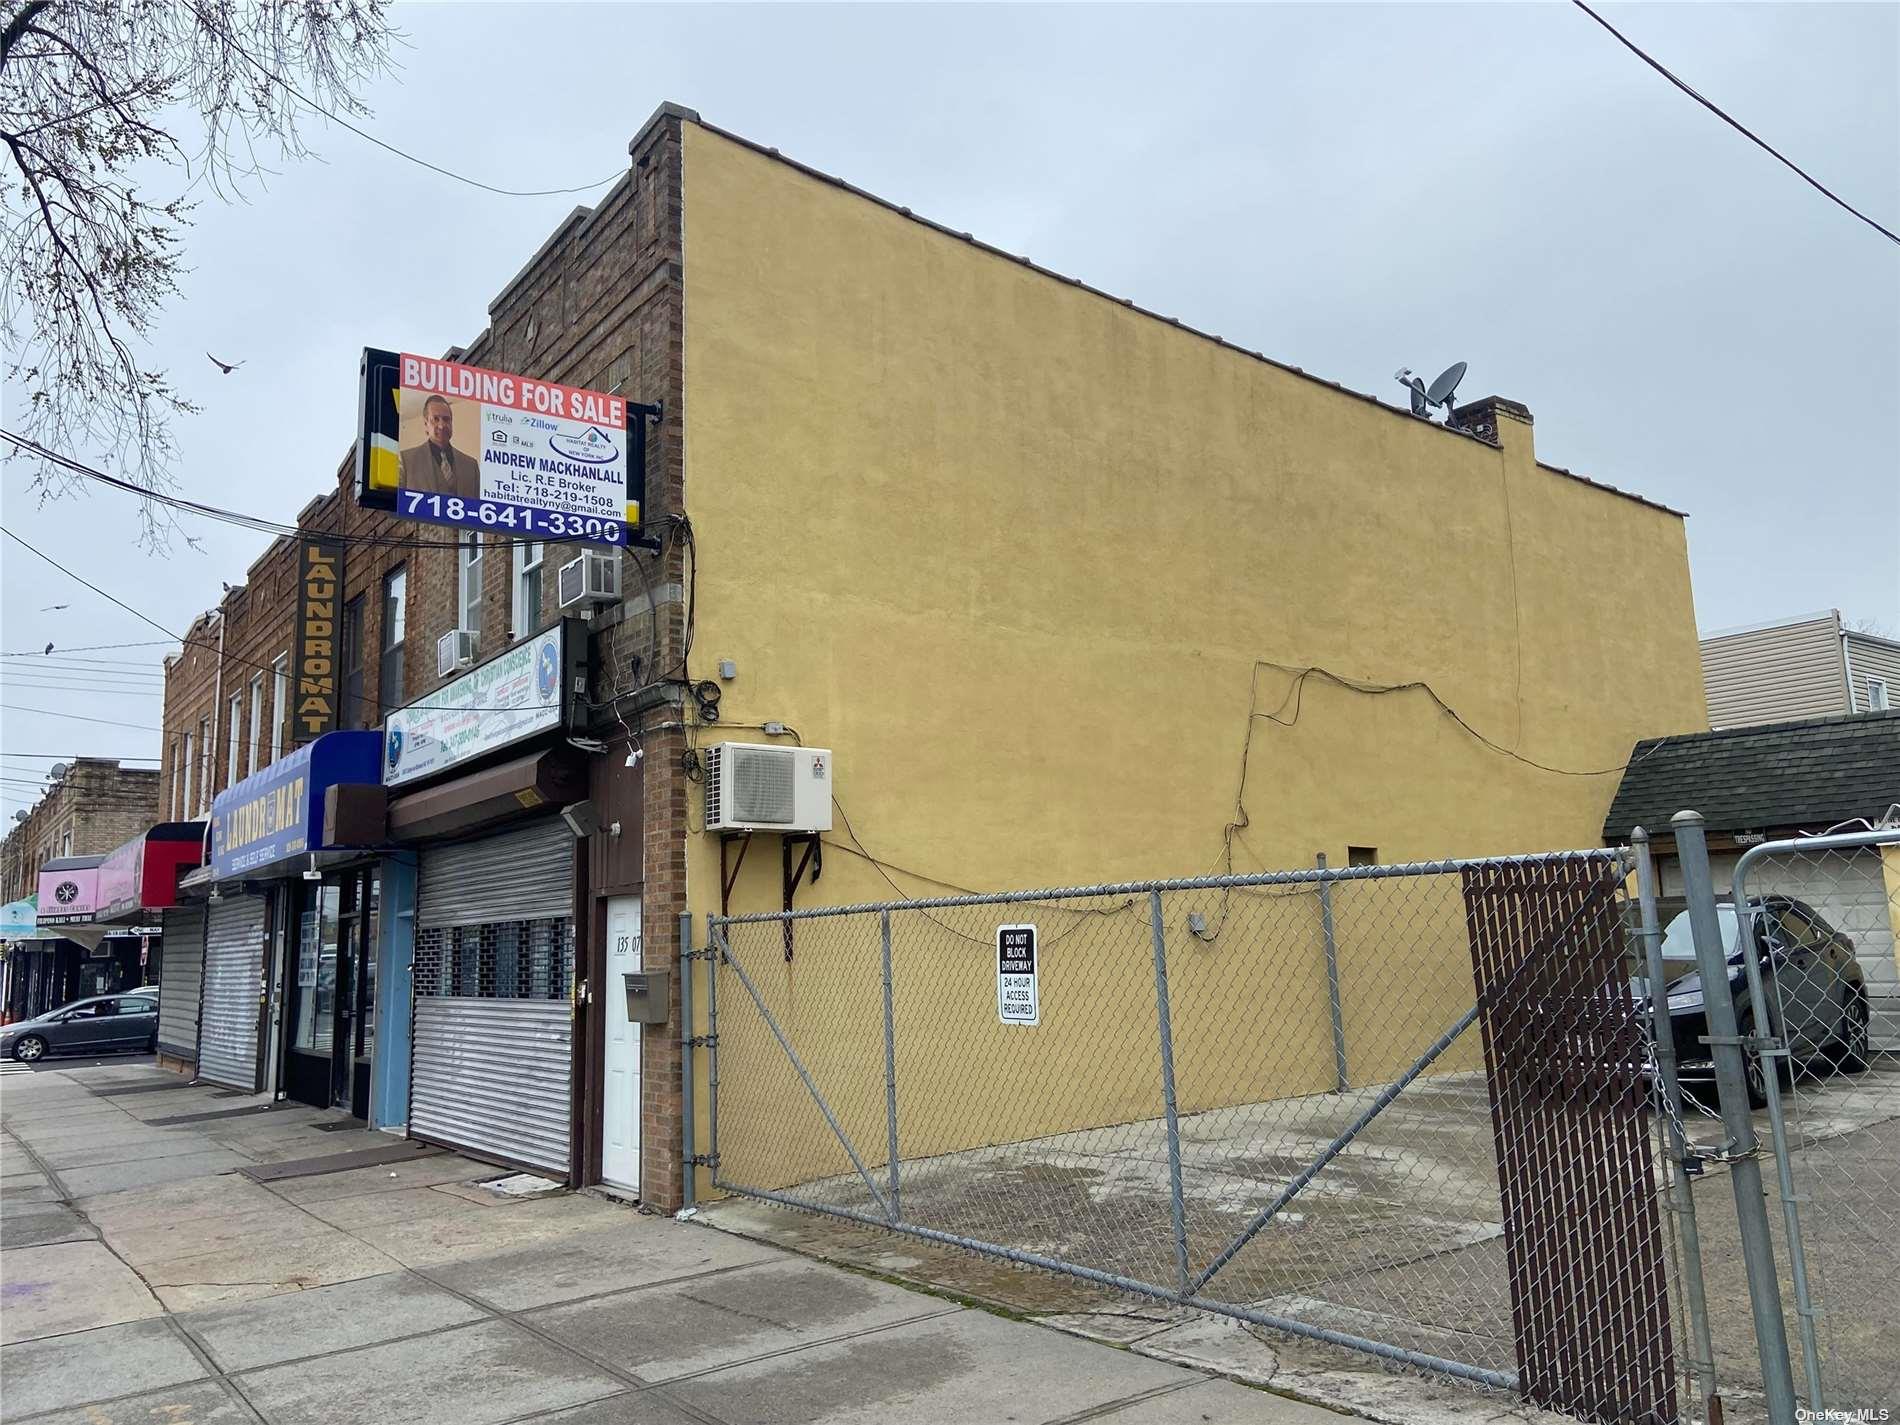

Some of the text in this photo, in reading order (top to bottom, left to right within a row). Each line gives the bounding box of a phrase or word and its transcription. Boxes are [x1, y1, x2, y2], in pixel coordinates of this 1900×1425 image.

[404, 358, 622, 427] BUILDING FOR SALE
[491, 413, 513, 425] trulia
[530, 417, 558, 432] Zillow
[566, 438, 606, 449] HABITAT REALTY
[484, 449, 624, 484] ANDREW MACKHANLALL
[511, 470, 597, 494] Lic. R.E Broker
[495, 480, 614, 508] Tel: 718-219-1508
[483, 489, 622, 518] habitatrealtyny@gmail.com
[404, 491, 620, 542] 718-641-3300
[298, 546, 336, 733] LAUNDROMAT
[617, 936, 641, 952] 135 07
[1006, 934, 1027, 945] DO NOT
[1007, 947, 1026, 958] BLOCK
[1002, 960, 1032, 971] DRIVEWAY
[1004, 977, 1030, 988] 24 HOUR
[1006, 990, 1029, 1001] ACCESS
[1004, 1003, 1033, 1015] REQUIRED
